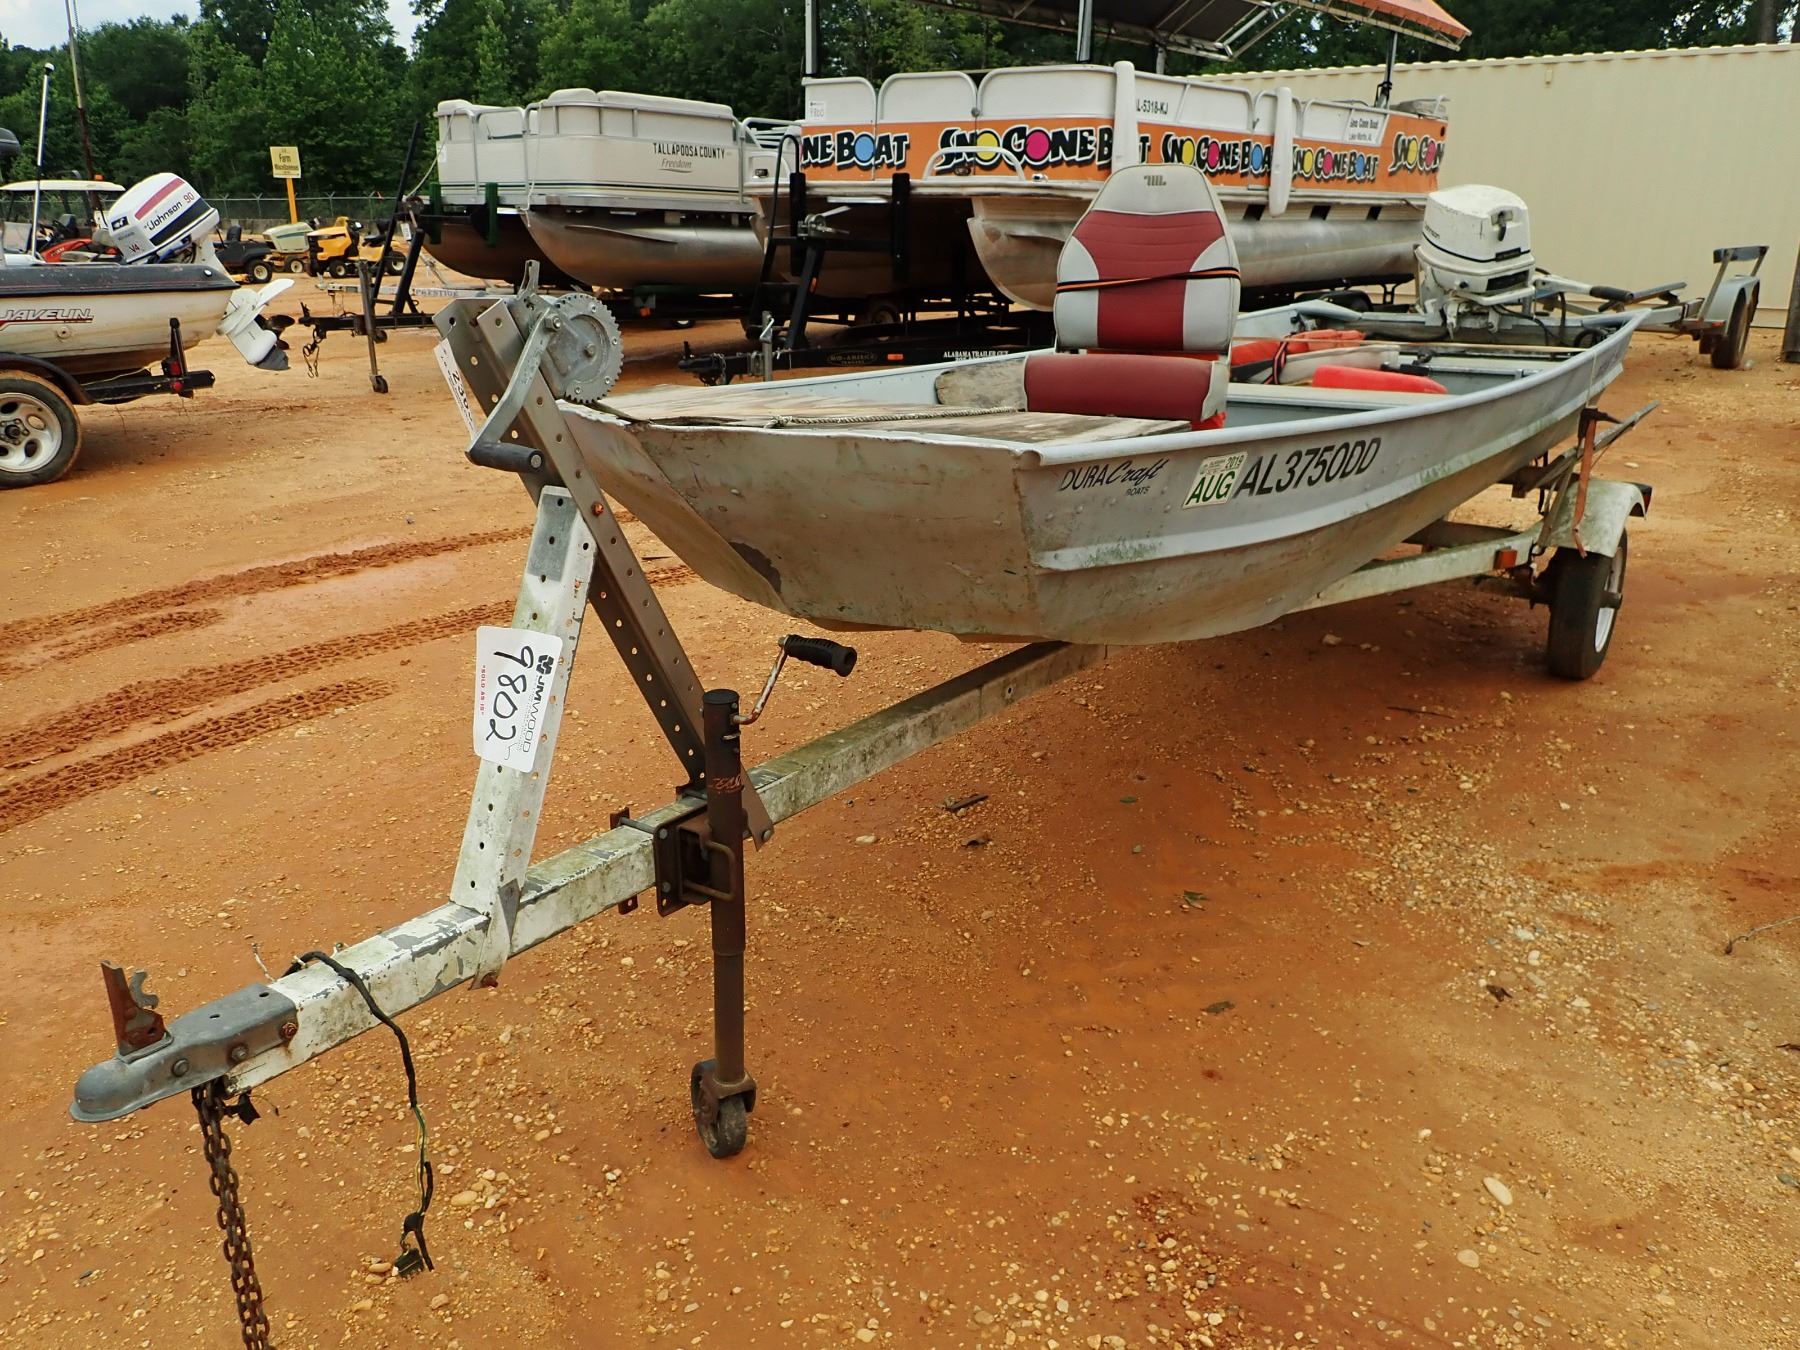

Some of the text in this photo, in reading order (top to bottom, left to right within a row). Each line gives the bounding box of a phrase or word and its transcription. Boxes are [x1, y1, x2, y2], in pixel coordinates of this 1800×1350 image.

[1135, 98, 1169, 115] L-5318-KJ
[653, 142, 725, 159] TALLAPOOSA COUNTY
[661, 157, 693, 169] Freedom
[801, 129, 911, 171] NE BOAT
[1239, 140, 1274, 178] BOA
[1346, 150, 1379, 184] BOAT
[145, 201, 184, 231] Johnson
[183, 191, 195, 204] 90
[0, 308, 94, 322] JAVELIN
[1184, 436, 1383, 506] AUG AL3750DD
[1224, 454, 1245, 469] 2019
[485, 645, 535, 742] 9802
